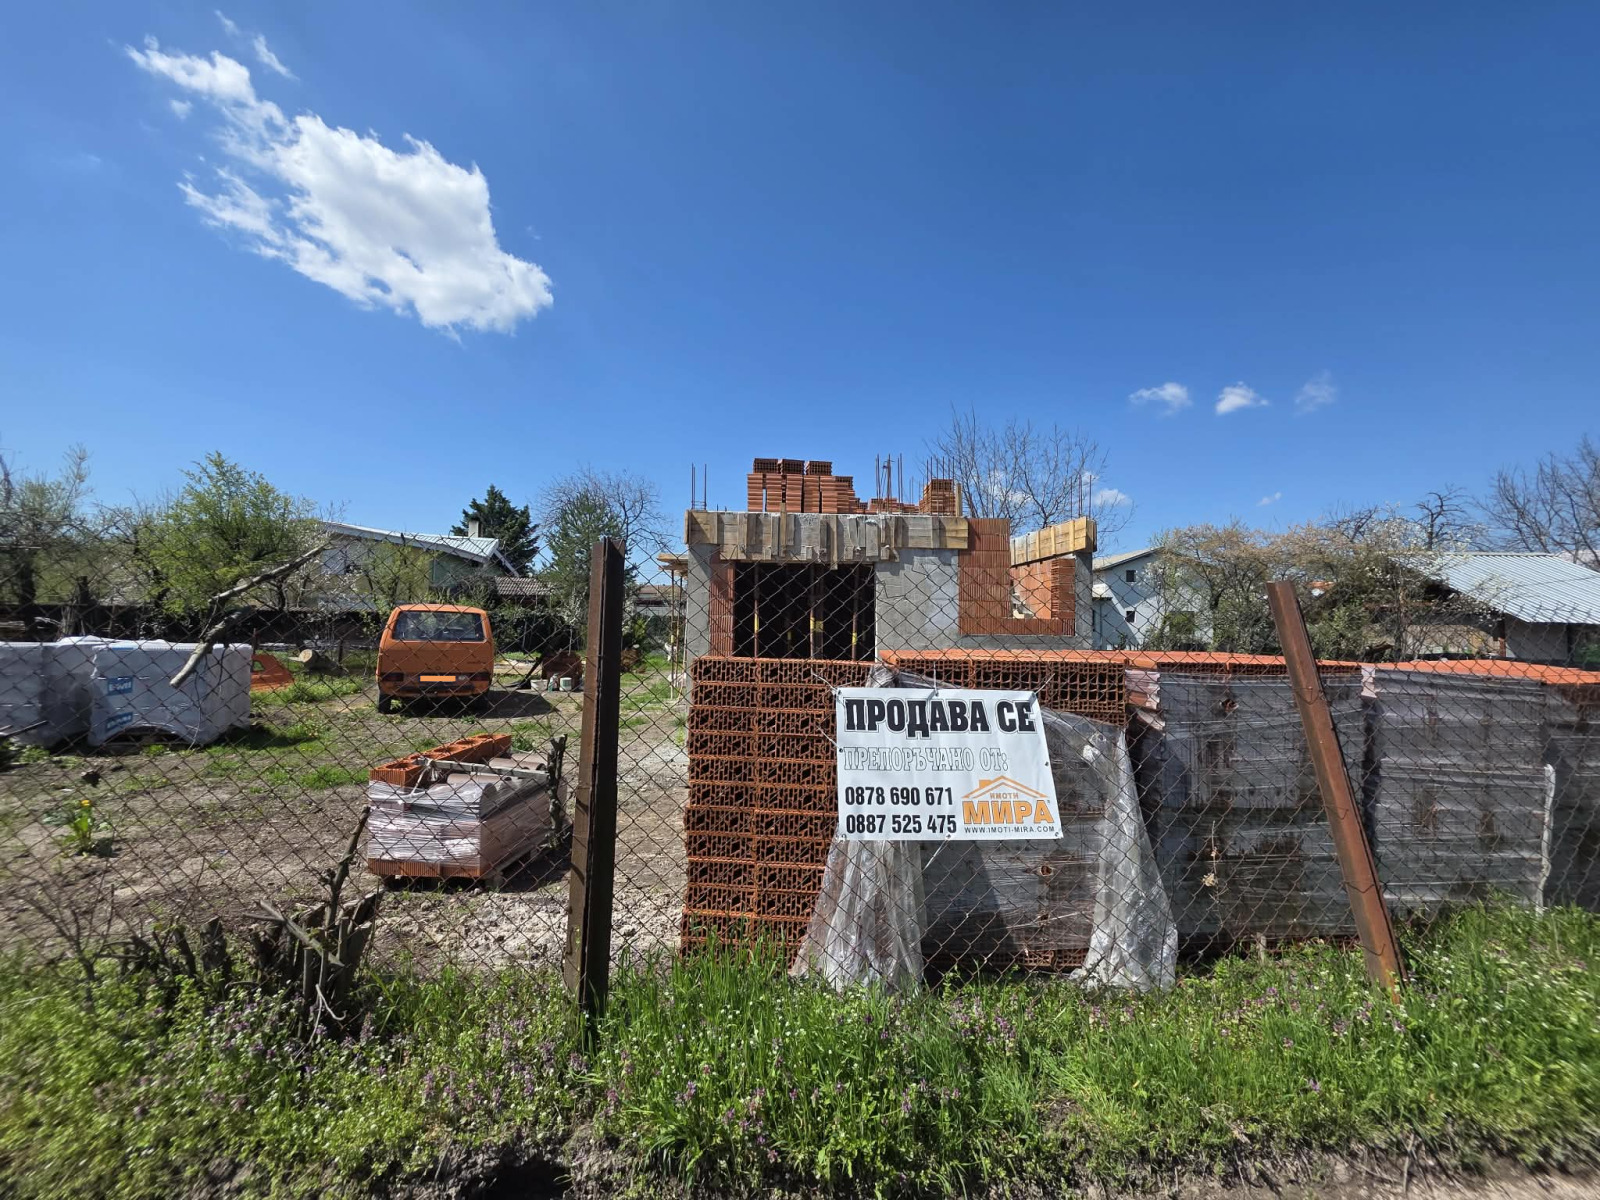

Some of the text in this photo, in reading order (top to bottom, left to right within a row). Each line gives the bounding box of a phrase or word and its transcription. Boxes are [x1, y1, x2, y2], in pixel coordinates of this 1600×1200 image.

[844, 698, 1037, 739] ПРОДАВА СЕ
[843, 747, 1009, 771] ПРЕПОРЪЧАНО ОТ:
[845, 786, 953, 806] 0878 690 671
[989, 792, 1019, 800] ИМОТИ
[962, 800, 1054, 825] МИРА
[846, 814, 957, 834] 0887 525 475
